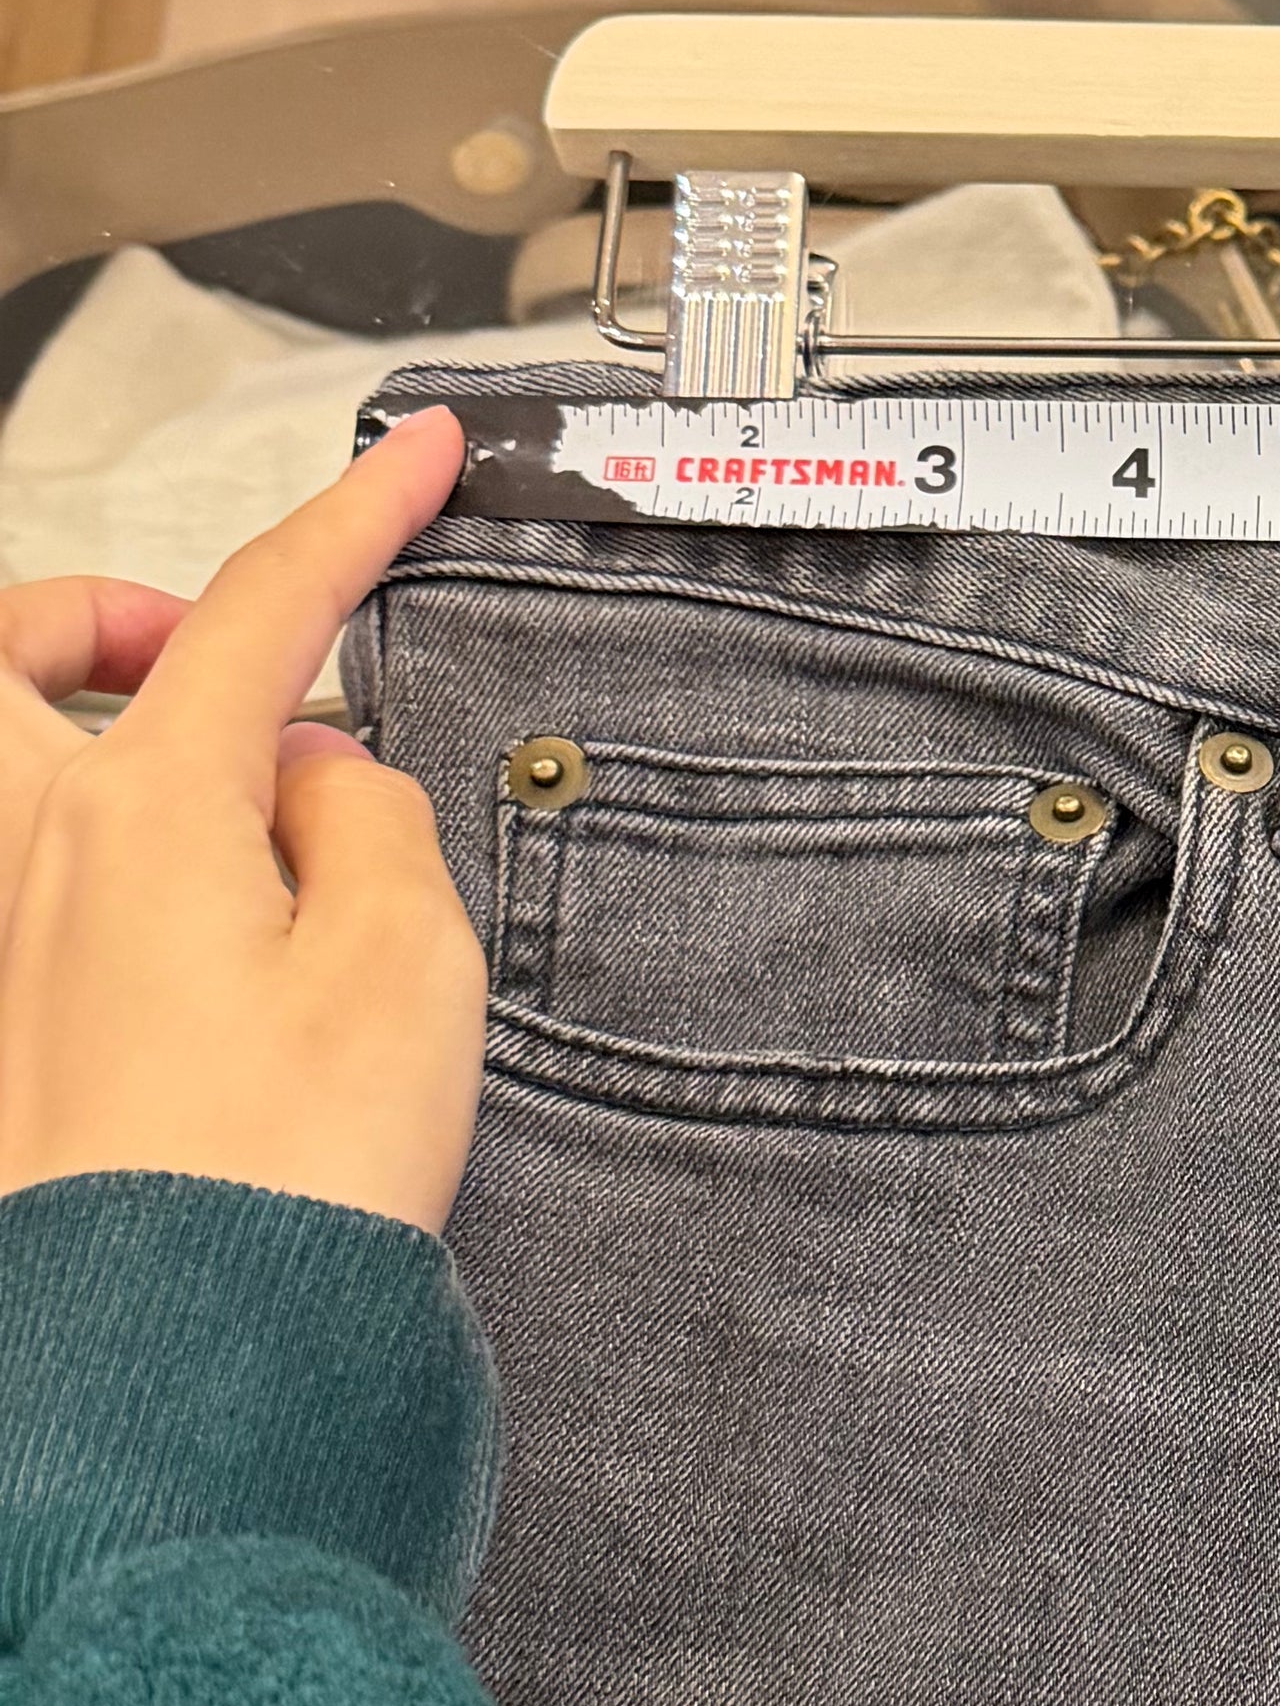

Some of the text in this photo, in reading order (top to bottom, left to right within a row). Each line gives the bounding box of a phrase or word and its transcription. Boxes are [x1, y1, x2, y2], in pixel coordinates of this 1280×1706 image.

[740, 424, 760, 448] 2
[914, 445, 958, 493] 3
[1112, 448, 1156, 498] 4
[734, 487, 755, 506] 2
